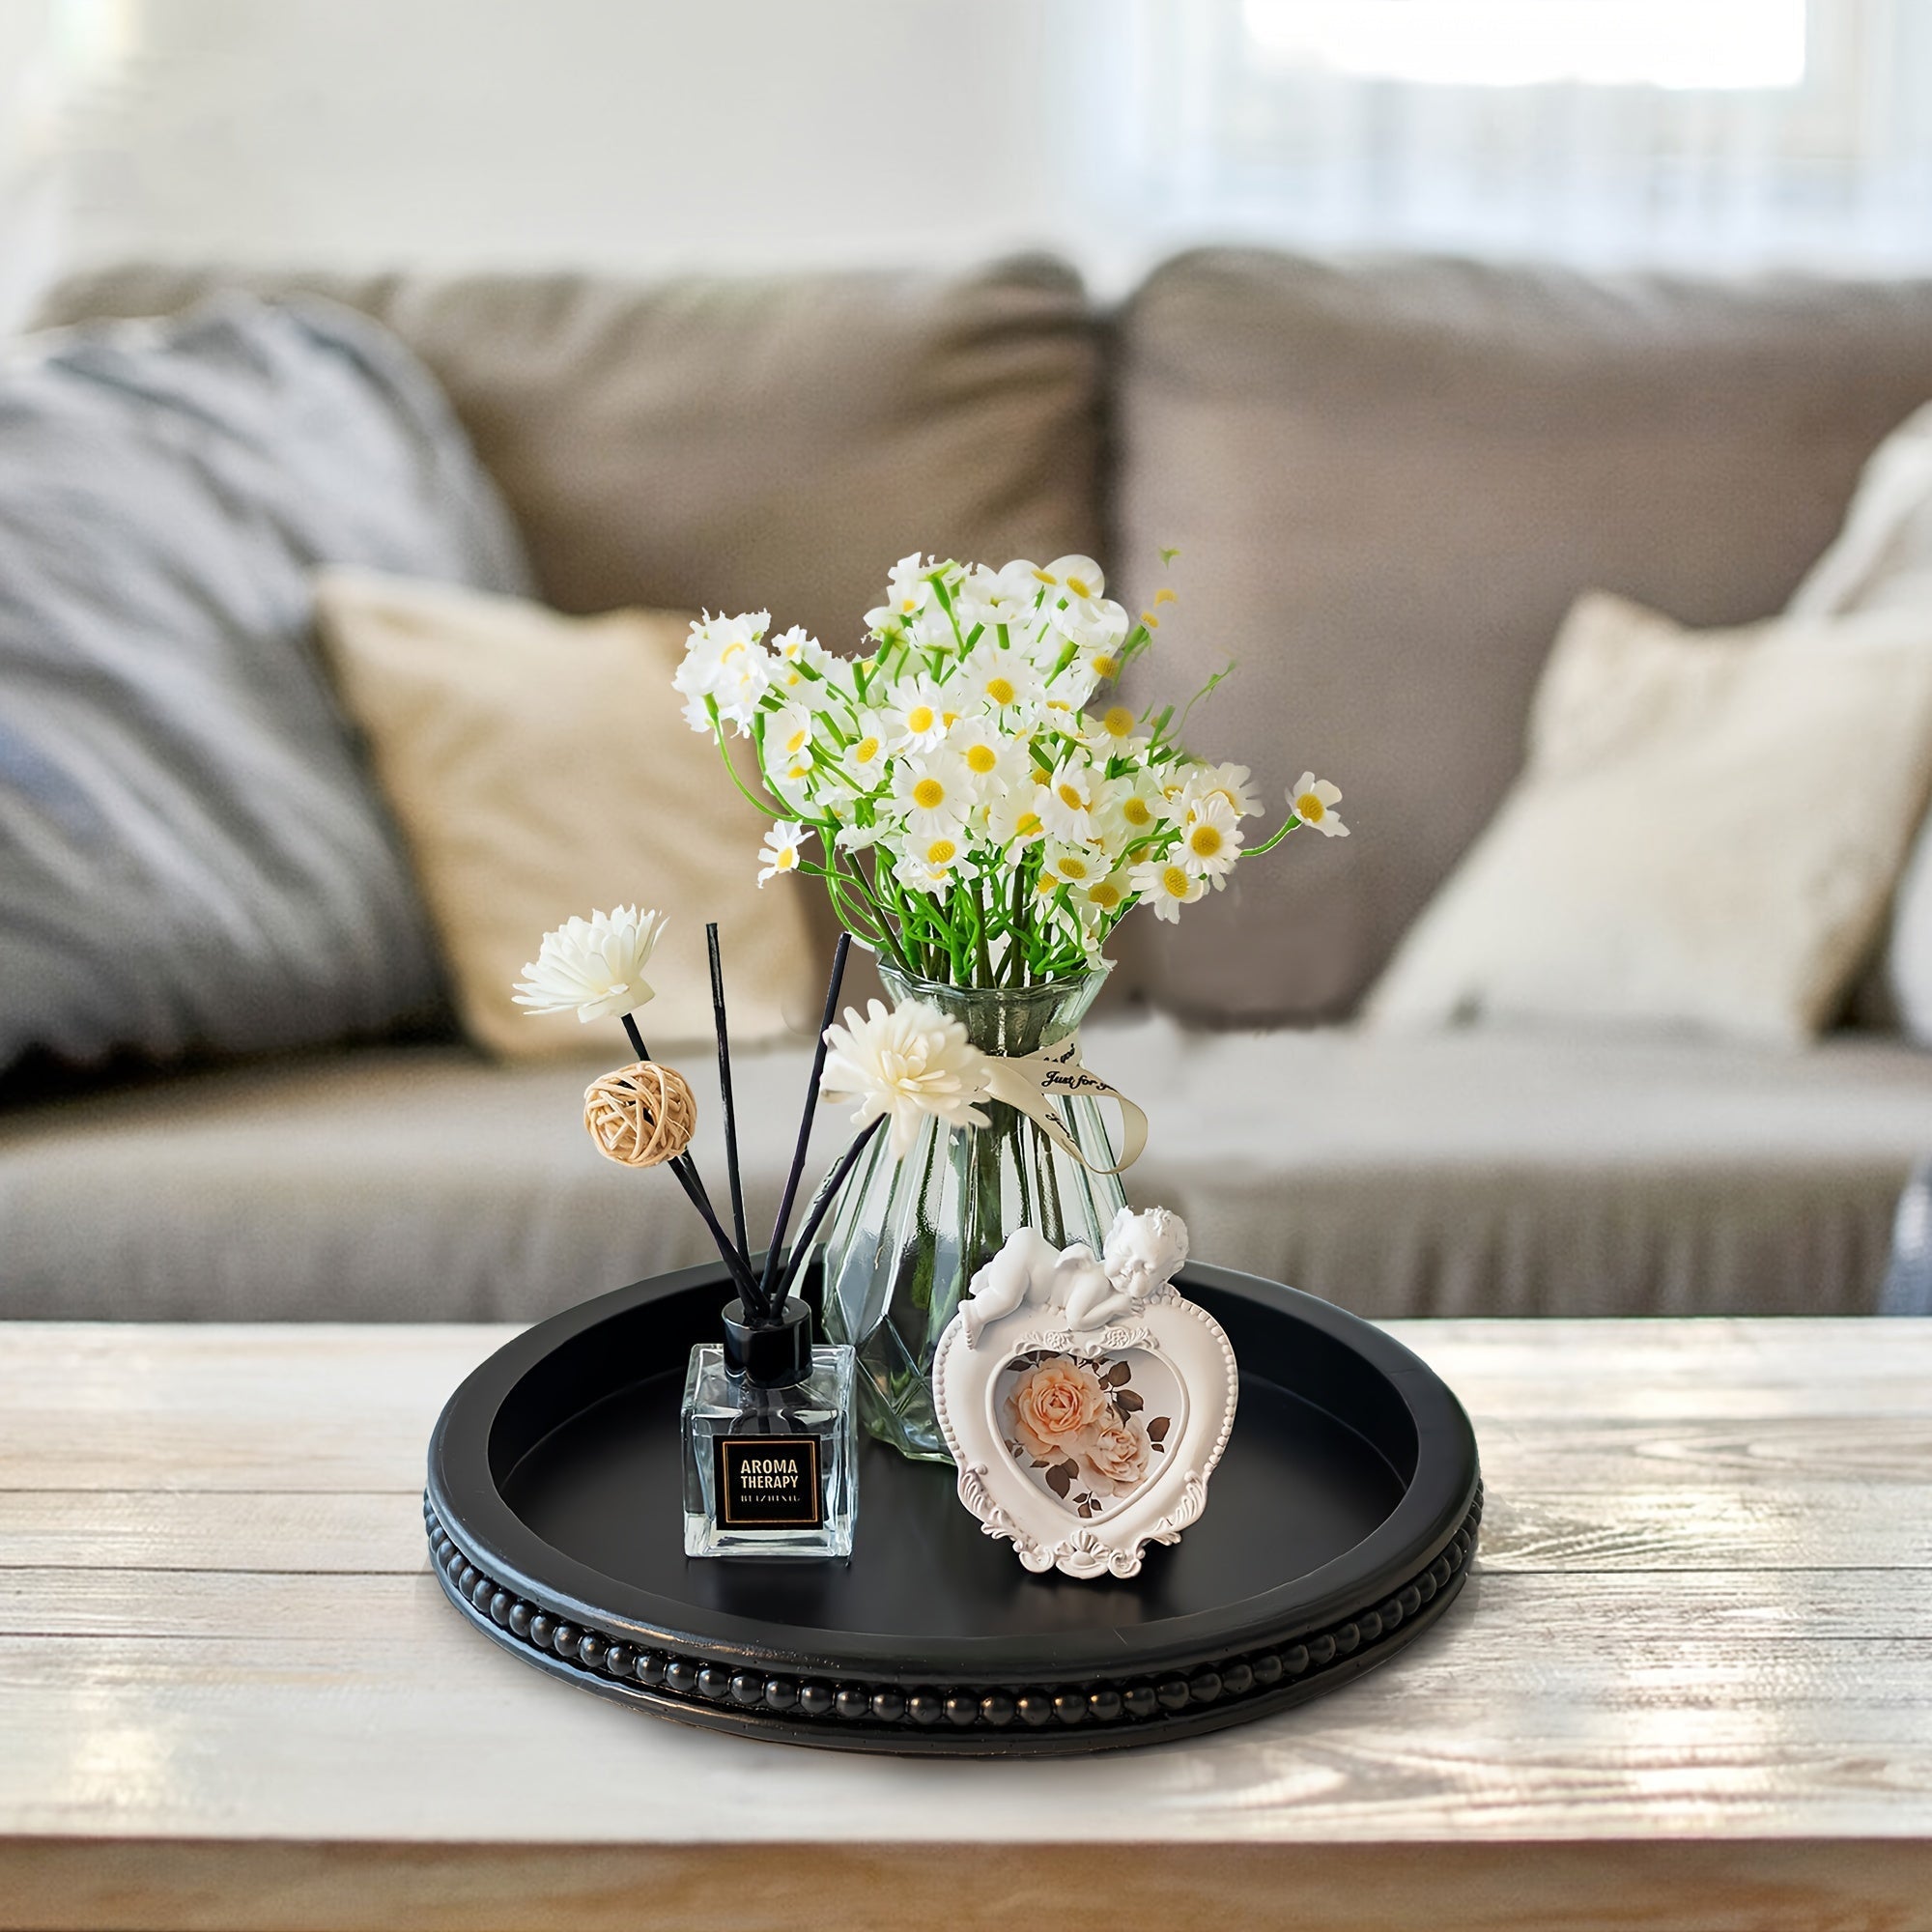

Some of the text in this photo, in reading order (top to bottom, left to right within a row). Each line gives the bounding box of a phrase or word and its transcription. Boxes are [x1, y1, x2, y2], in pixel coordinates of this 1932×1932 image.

[1041, 1070, 1074, 1087] Just
[1070, 1075, 1097, 1090] for
[740, 1460, 798, 1474] AROMA
[740, 1475, 799, 1489] THERAPY
